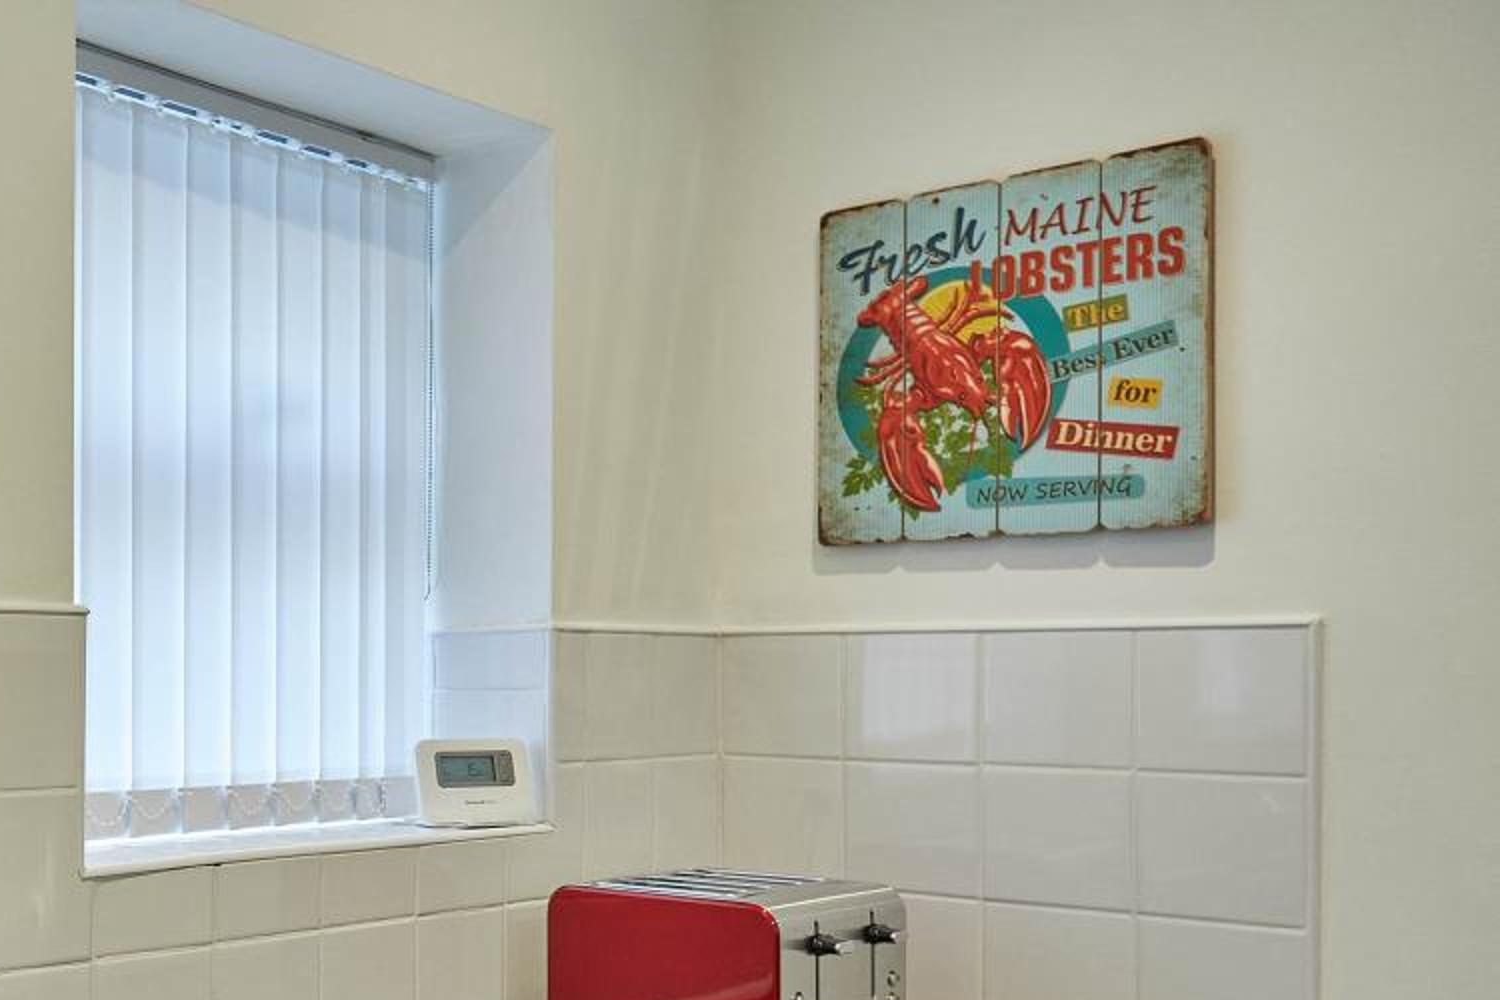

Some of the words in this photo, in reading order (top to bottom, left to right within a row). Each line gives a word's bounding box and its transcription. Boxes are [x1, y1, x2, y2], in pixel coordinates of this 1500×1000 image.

[836, 206, 987, 297] Fresh
[1004, 185, 1157, 246] MAINE
[969, 225, 1187, 302] LOBSTERS
[1067, 301, 1125, 328] The
[1112, 328, 1173, 361] Ever
[1113, 378, 1157, 403] for
[1055, 420, 1174, 453] Dinner
[976, 483, 1028, 504] NOW
[1035, 475, 1132, 500] SERVING
